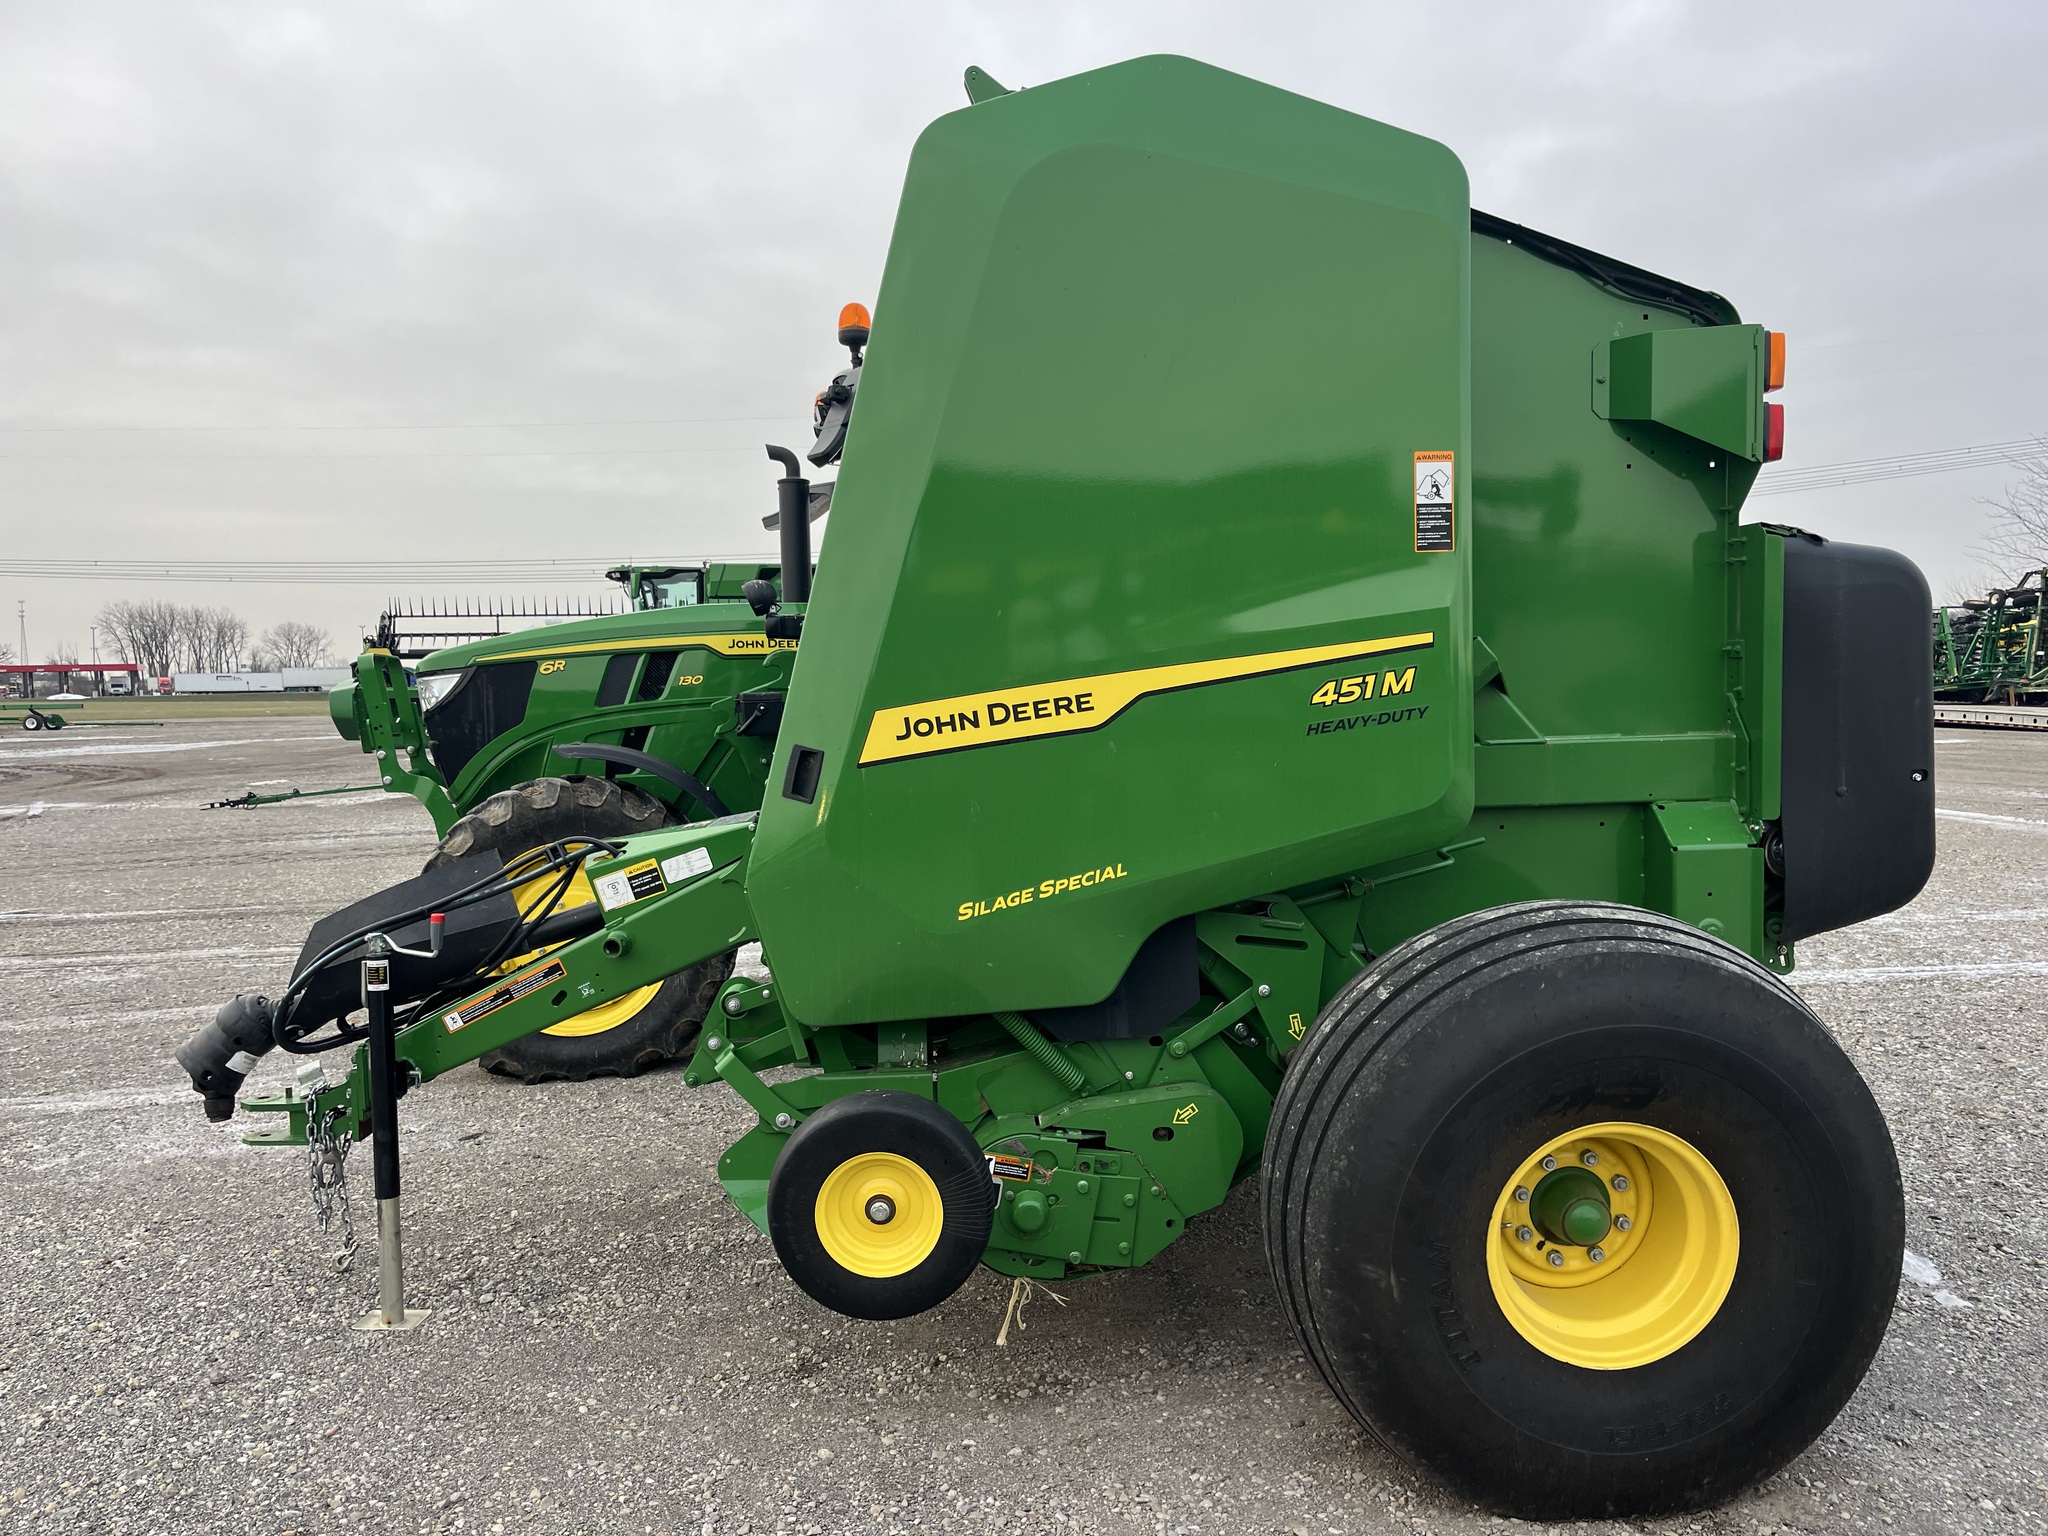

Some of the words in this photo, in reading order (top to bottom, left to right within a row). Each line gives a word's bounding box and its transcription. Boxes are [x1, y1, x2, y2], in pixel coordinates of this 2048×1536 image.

[728, 639, 764, 649] JOHN
[539, 659, 567, 675] 6R
[678, 674, 704, 686] 130
[896, 710, 980, 741] JOHN
[987, 693, 1095, 726] DEERE
[1306, 705, 1430, 736] HEAVY-DUTY
[632, 862, 654, 873] CAUTION
[958, 887, 1035, 921] SILAGE
[1039, 863, 1128, 899] SPECIAL
[1428, 1241, 1483, 1374] TITAN
